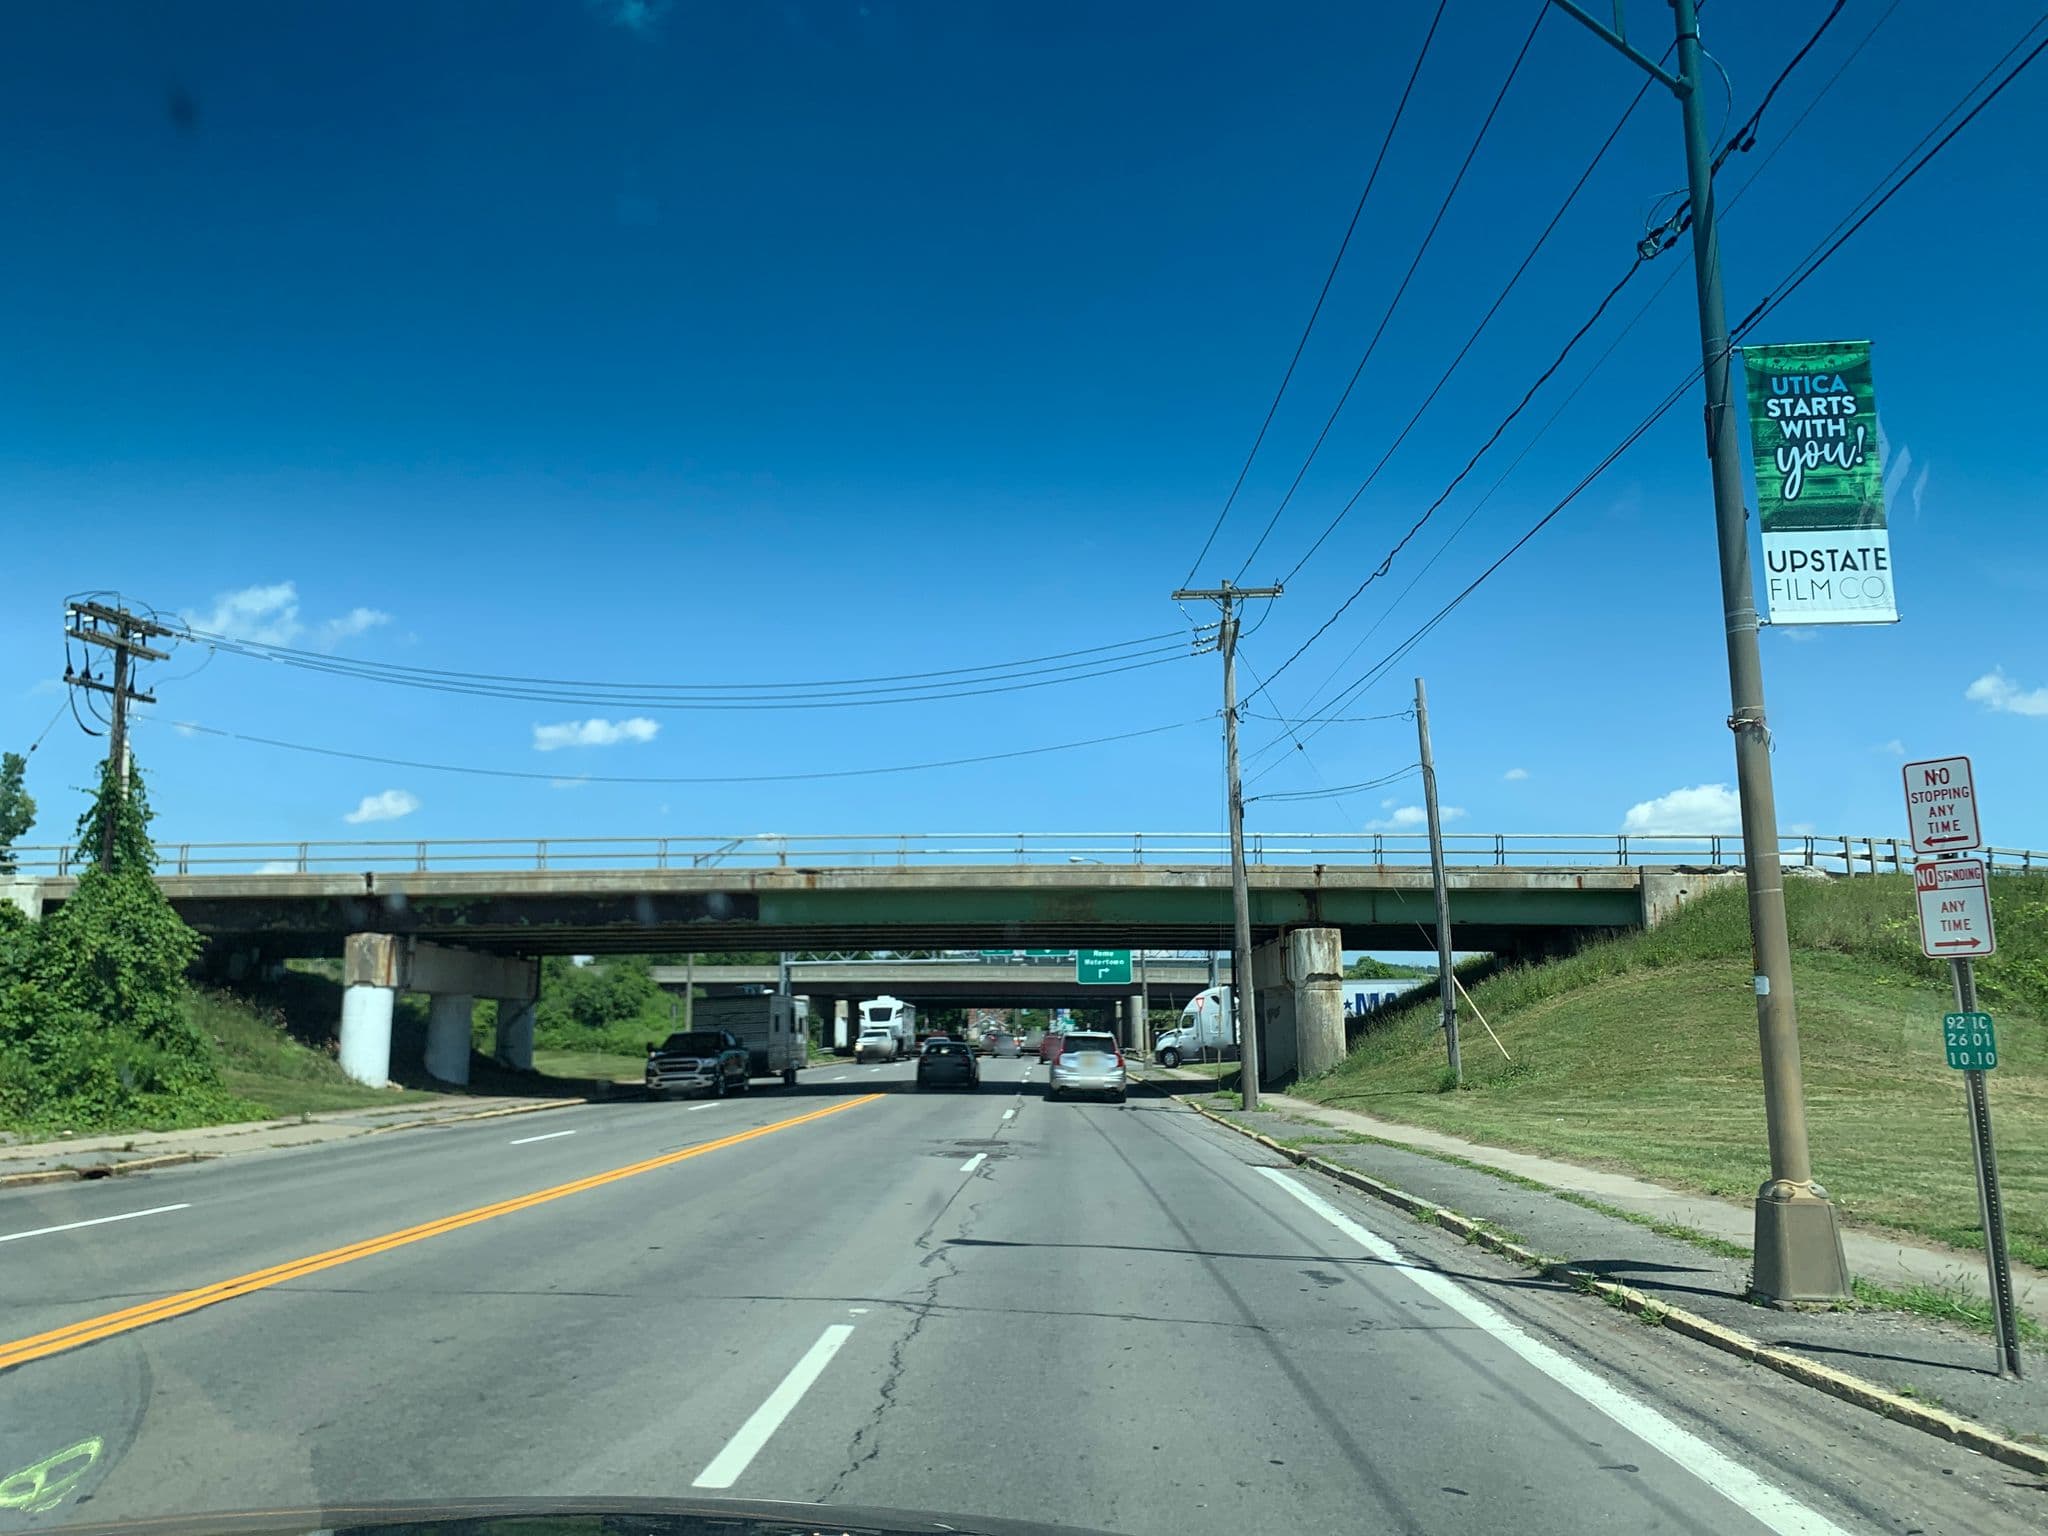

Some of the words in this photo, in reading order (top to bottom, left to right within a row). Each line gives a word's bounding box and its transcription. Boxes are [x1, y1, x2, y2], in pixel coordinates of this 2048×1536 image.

[1771, 375, 1848, 395] UTICA
[1766, 395, 1857, 417] STARTS
[1780, 418, 1846, 439] WITH
[1776, 426, 1865, 499] you!
[1768, 548, 1888, 573] UPSTATE
[1770, 577, 1832, 601] FILM
[1839, 576, 1886, 600] CO
[1924, 767, 1950, 786] NO
[1911, 786, 1970, 804] STOPPING
[1929, 804, 1955, 818] ANY
[1928, 819, 1961, 834] TIME
[1916, 868, 1936, 887] NO
[1937, 867, 1981, 883] STANDING
[1941, 900, 1966, 913] ANY
[1940, 918, 1972, 932] TIME
